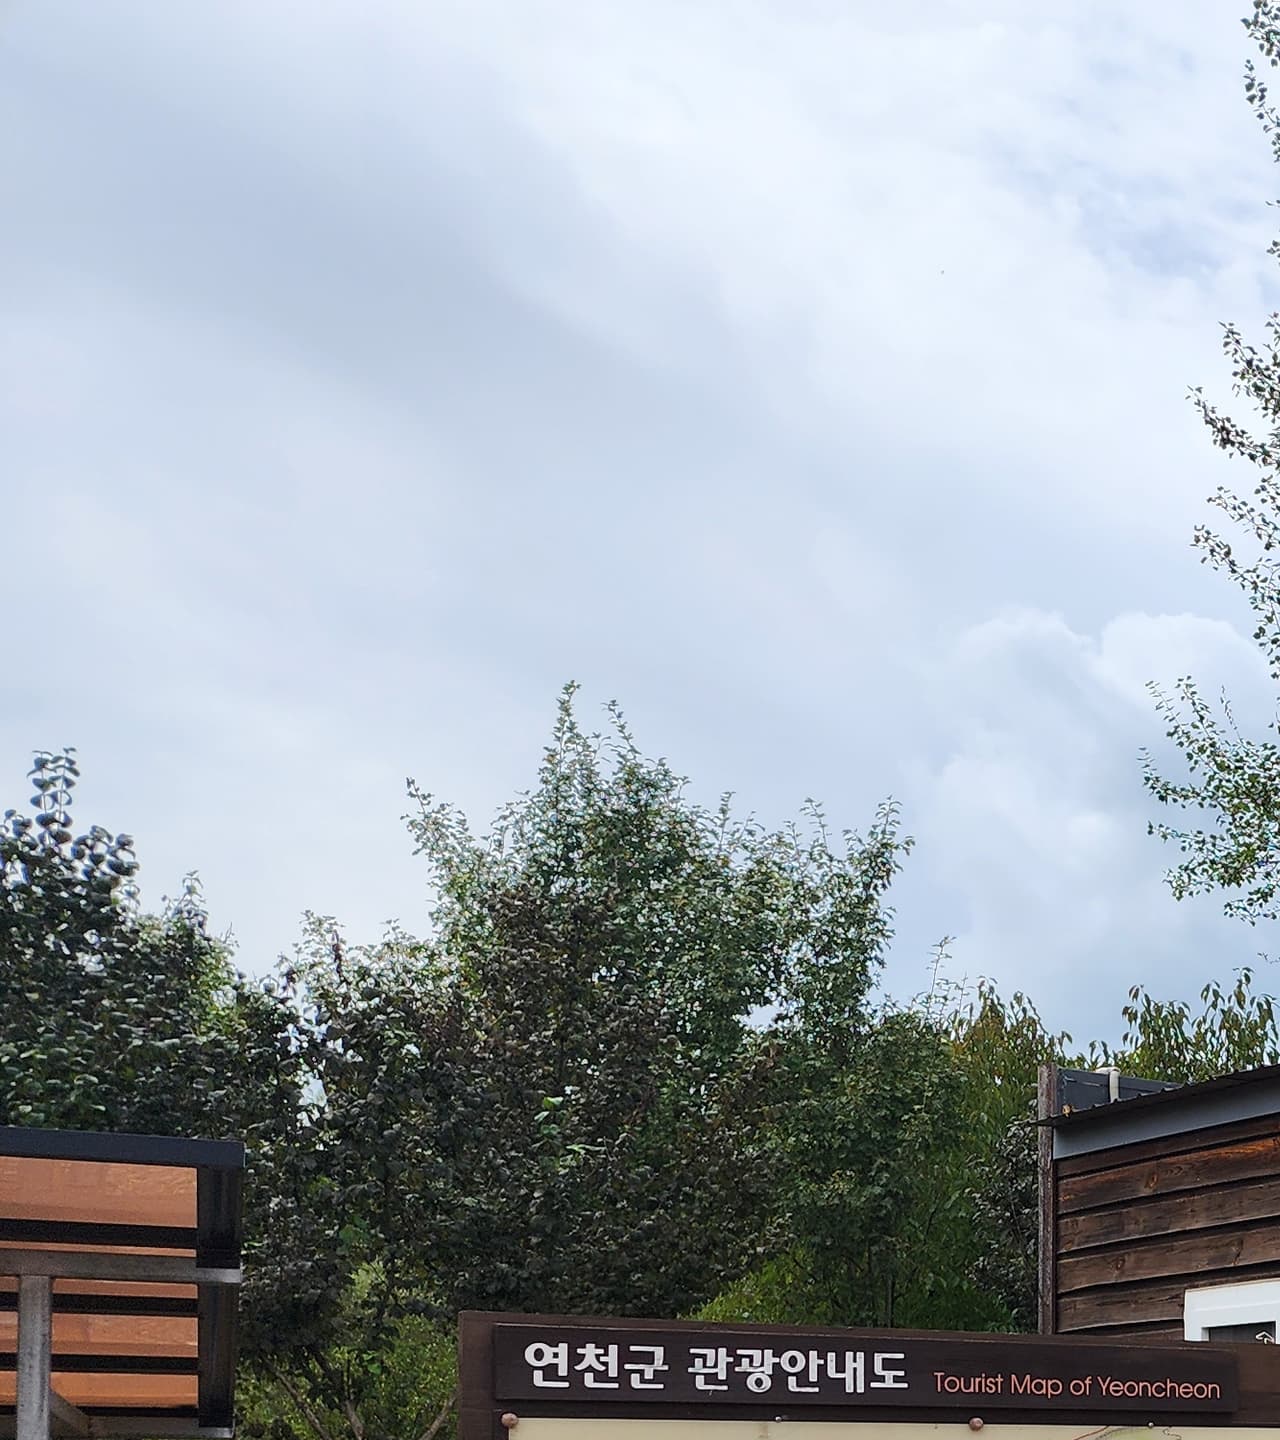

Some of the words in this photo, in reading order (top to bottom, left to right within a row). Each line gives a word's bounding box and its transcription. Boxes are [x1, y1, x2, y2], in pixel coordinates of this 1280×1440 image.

[524, 1342, 669, 1389] 연천군
[688, 1347, 910, 1394] 관광안내도
[934, 1372, 1004, 1394] Tourist
[1010, 1374, 1063, 1399] Map
[1070, 1376, 1092, 1396] of
[1097, 1376, 1221, 1399] Yeoncheon
